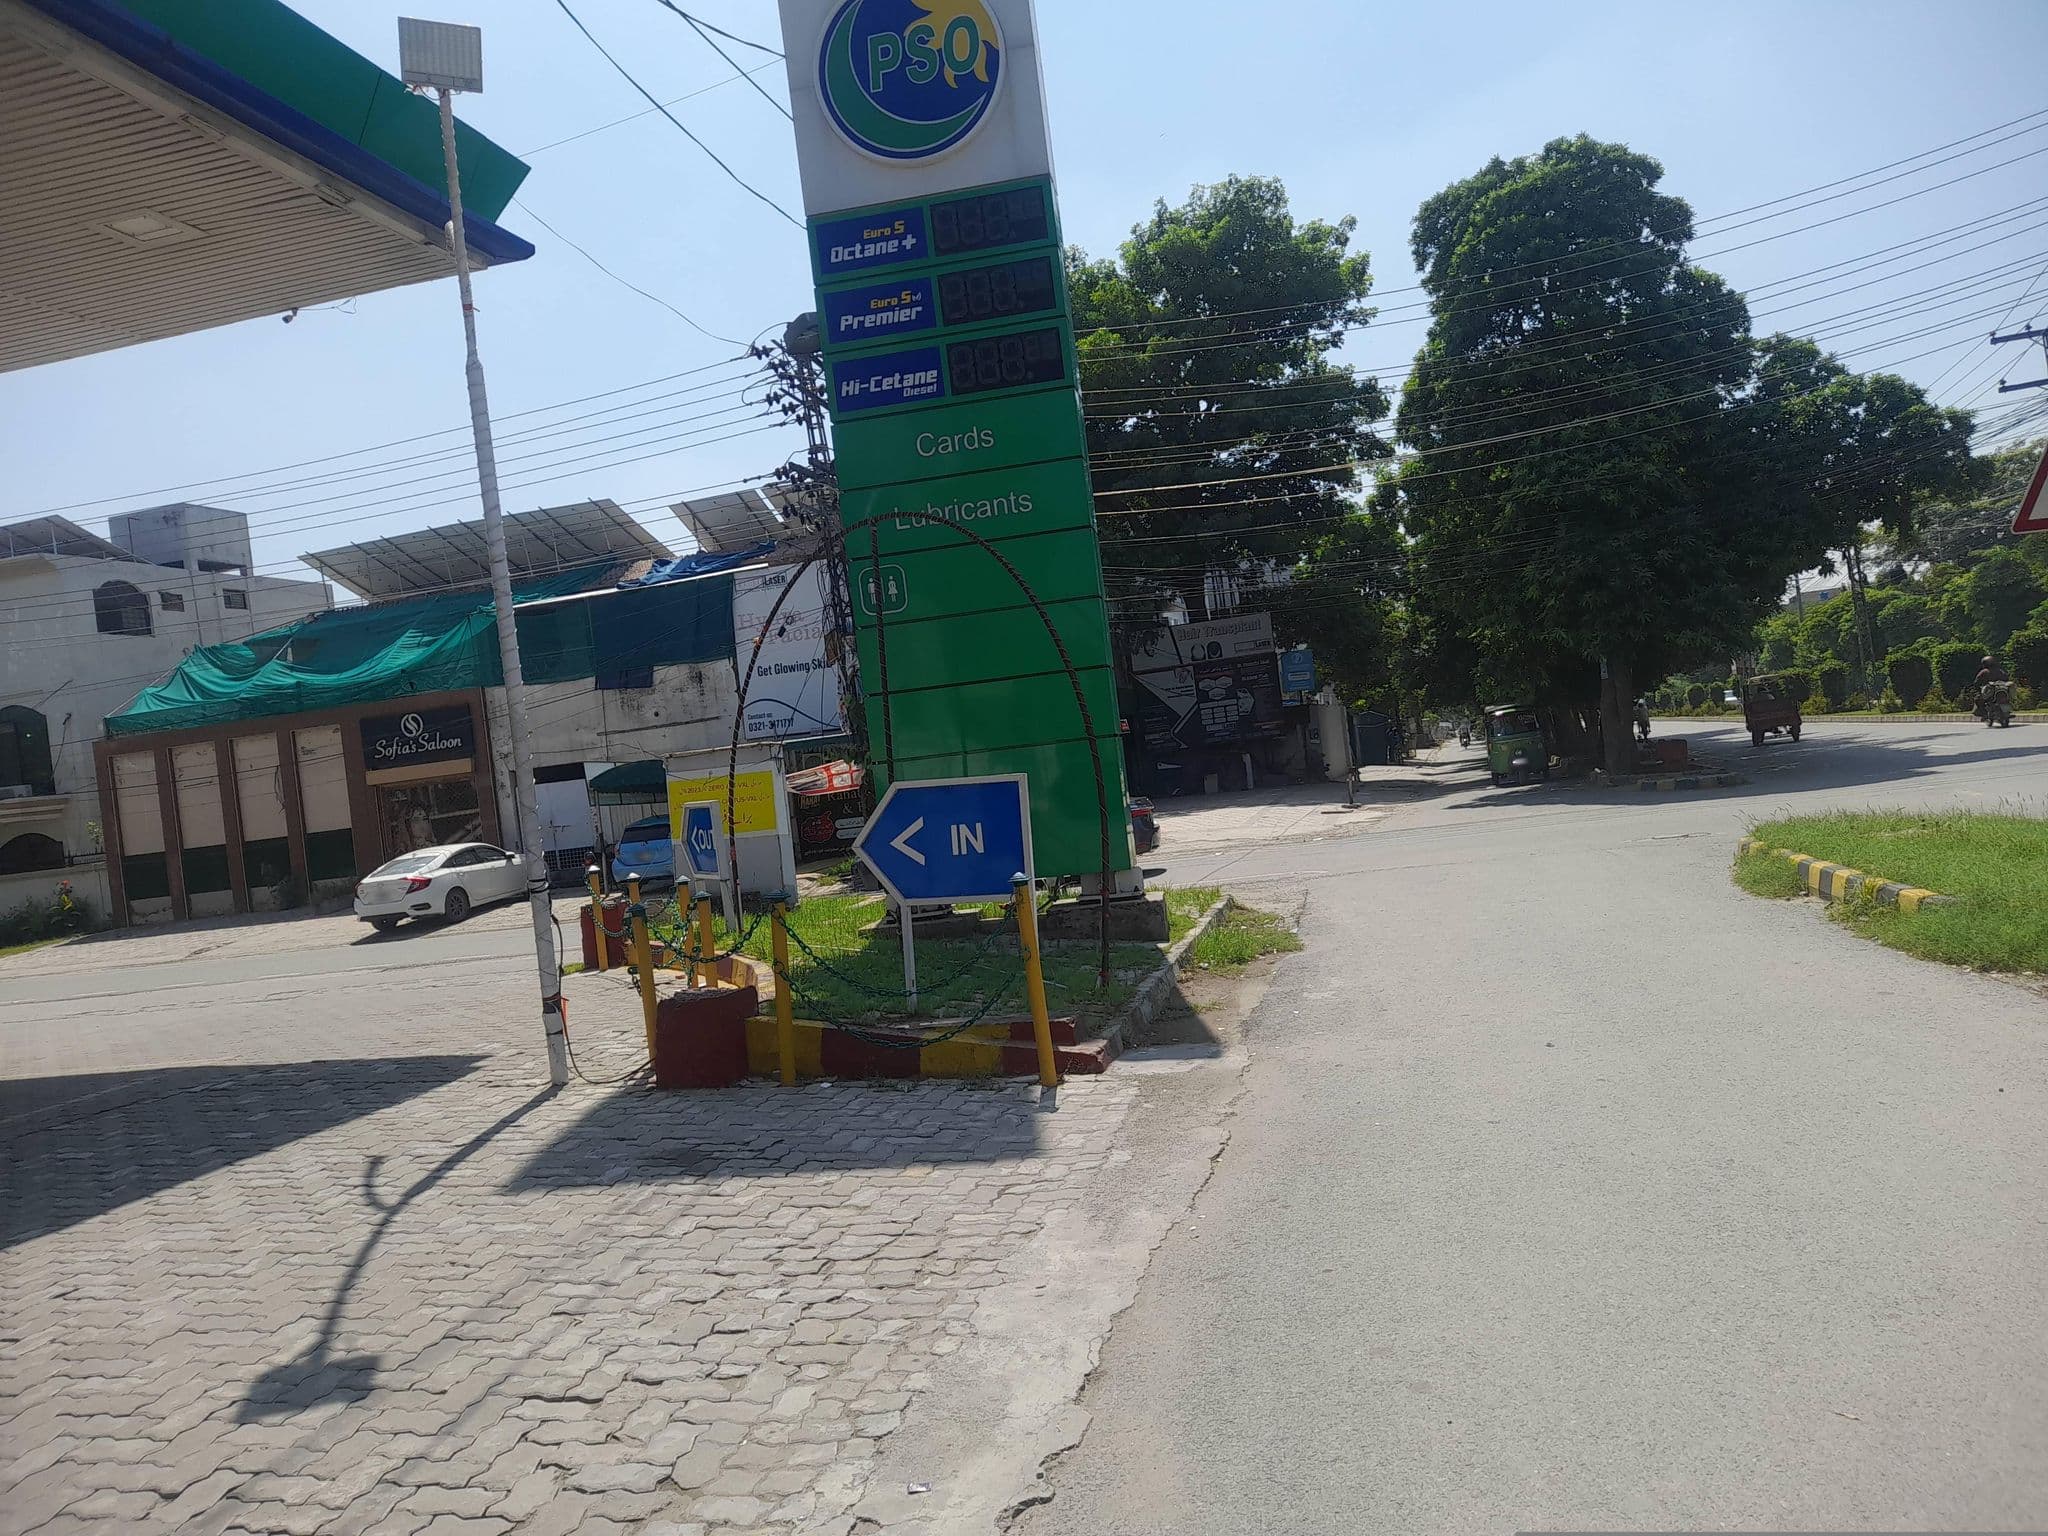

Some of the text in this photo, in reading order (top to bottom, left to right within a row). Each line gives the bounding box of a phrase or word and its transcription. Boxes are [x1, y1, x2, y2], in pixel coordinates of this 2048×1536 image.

[867, 14, 981, 93] PSO
[863, 220, 905, 240] Euro 5
[870, 297, 899, 309] Euro
[840, 306, 923, 331] Premier
[841, 369, 938, 397] Hi-Cetane
[903, 383, 937, 397] Diesel
[916, 426, 995, 457] Cards
[895, 491, 1033, 530] Lubricants
[757, 665, 773, 677] Get
[774, 661, 810, 675] Glowing
[375, 732, 462, 760] Sofia's Saloon
[951, 823, 984, 855] IN
